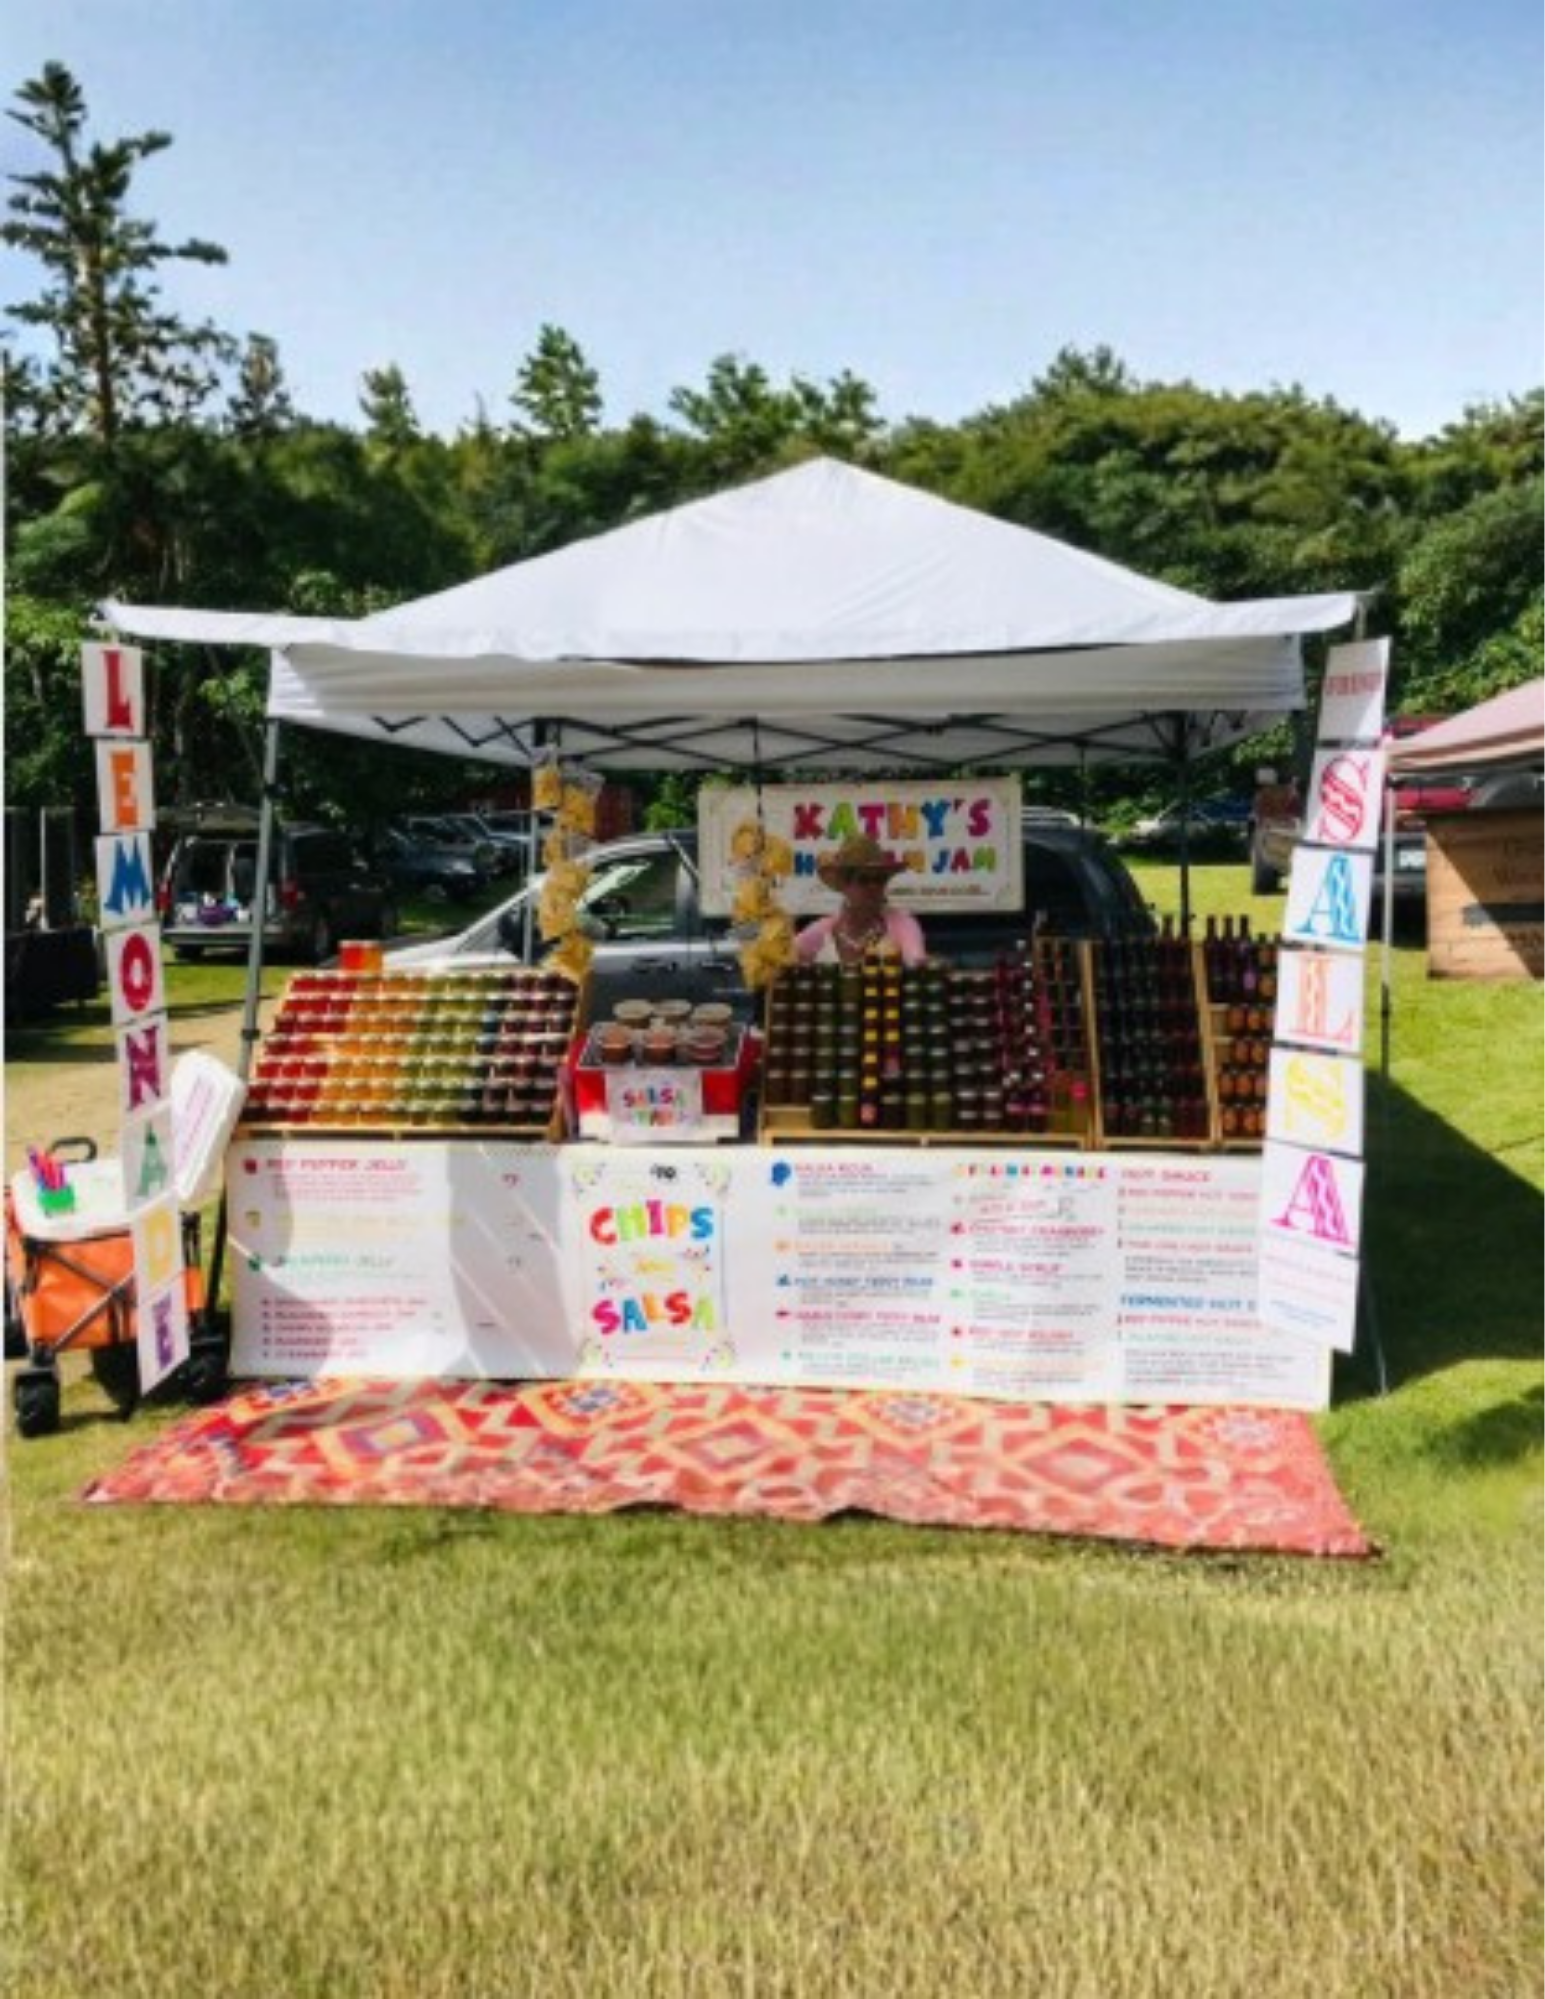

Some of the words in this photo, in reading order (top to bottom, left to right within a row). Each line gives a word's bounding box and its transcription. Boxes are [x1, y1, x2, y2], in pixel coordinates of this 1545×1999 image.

[794, 798, 991, 840] KATHY'S
[931, 846, 996, 874] JAM
[103, 648, 175, 1370] LEMONADE
[1268, 756, 1369, 1246] SALSA
[623, 1085, 686, 1107] SALSA
[589, 1199, 714, 1245] CHIPS
[591, 1291, 715, 1334] SALSA
